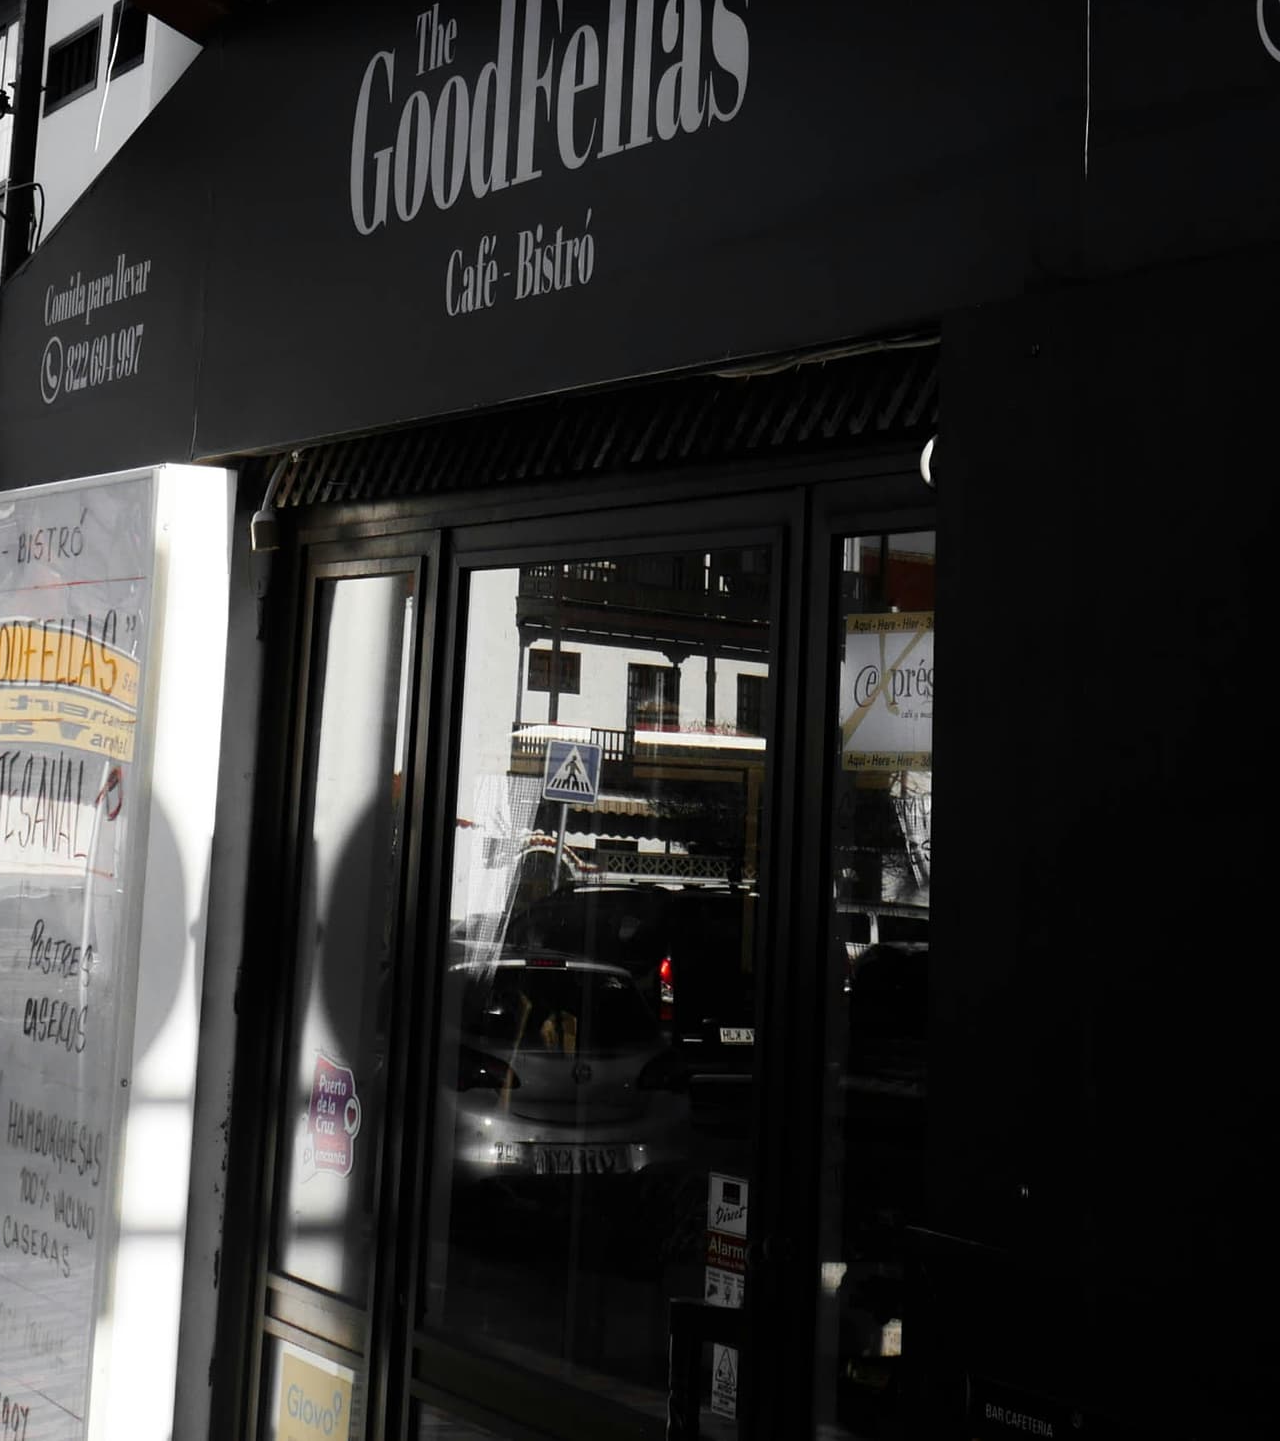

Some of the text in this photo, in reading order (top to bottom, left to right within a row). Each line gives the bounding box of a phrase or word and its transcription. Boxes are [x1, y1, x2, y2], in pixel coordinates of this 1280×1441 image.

[415, 2, 458, 77] The
[44, 253, 152, 327] Comida para llevar
[445, 235, 497, 318] Café
[514, 208, 596, 301] Bistró
[65, 323, 144, 393] 822 694 997
[17, 507, 88, 564] BISTRÓ
[28, 919, 94, 987] POSTRES
[23, 996, 89, 1053] CASEROS
[319, 1074, 347, 1096] Puerto
[7, 1099, 102, 1186] HAMBURGUESAS
[315, 1116, 336, 1135] Cruz
[3, 1215, 71, 1278] CASERAS
[984, 1402, 1004, 1423] BAR
